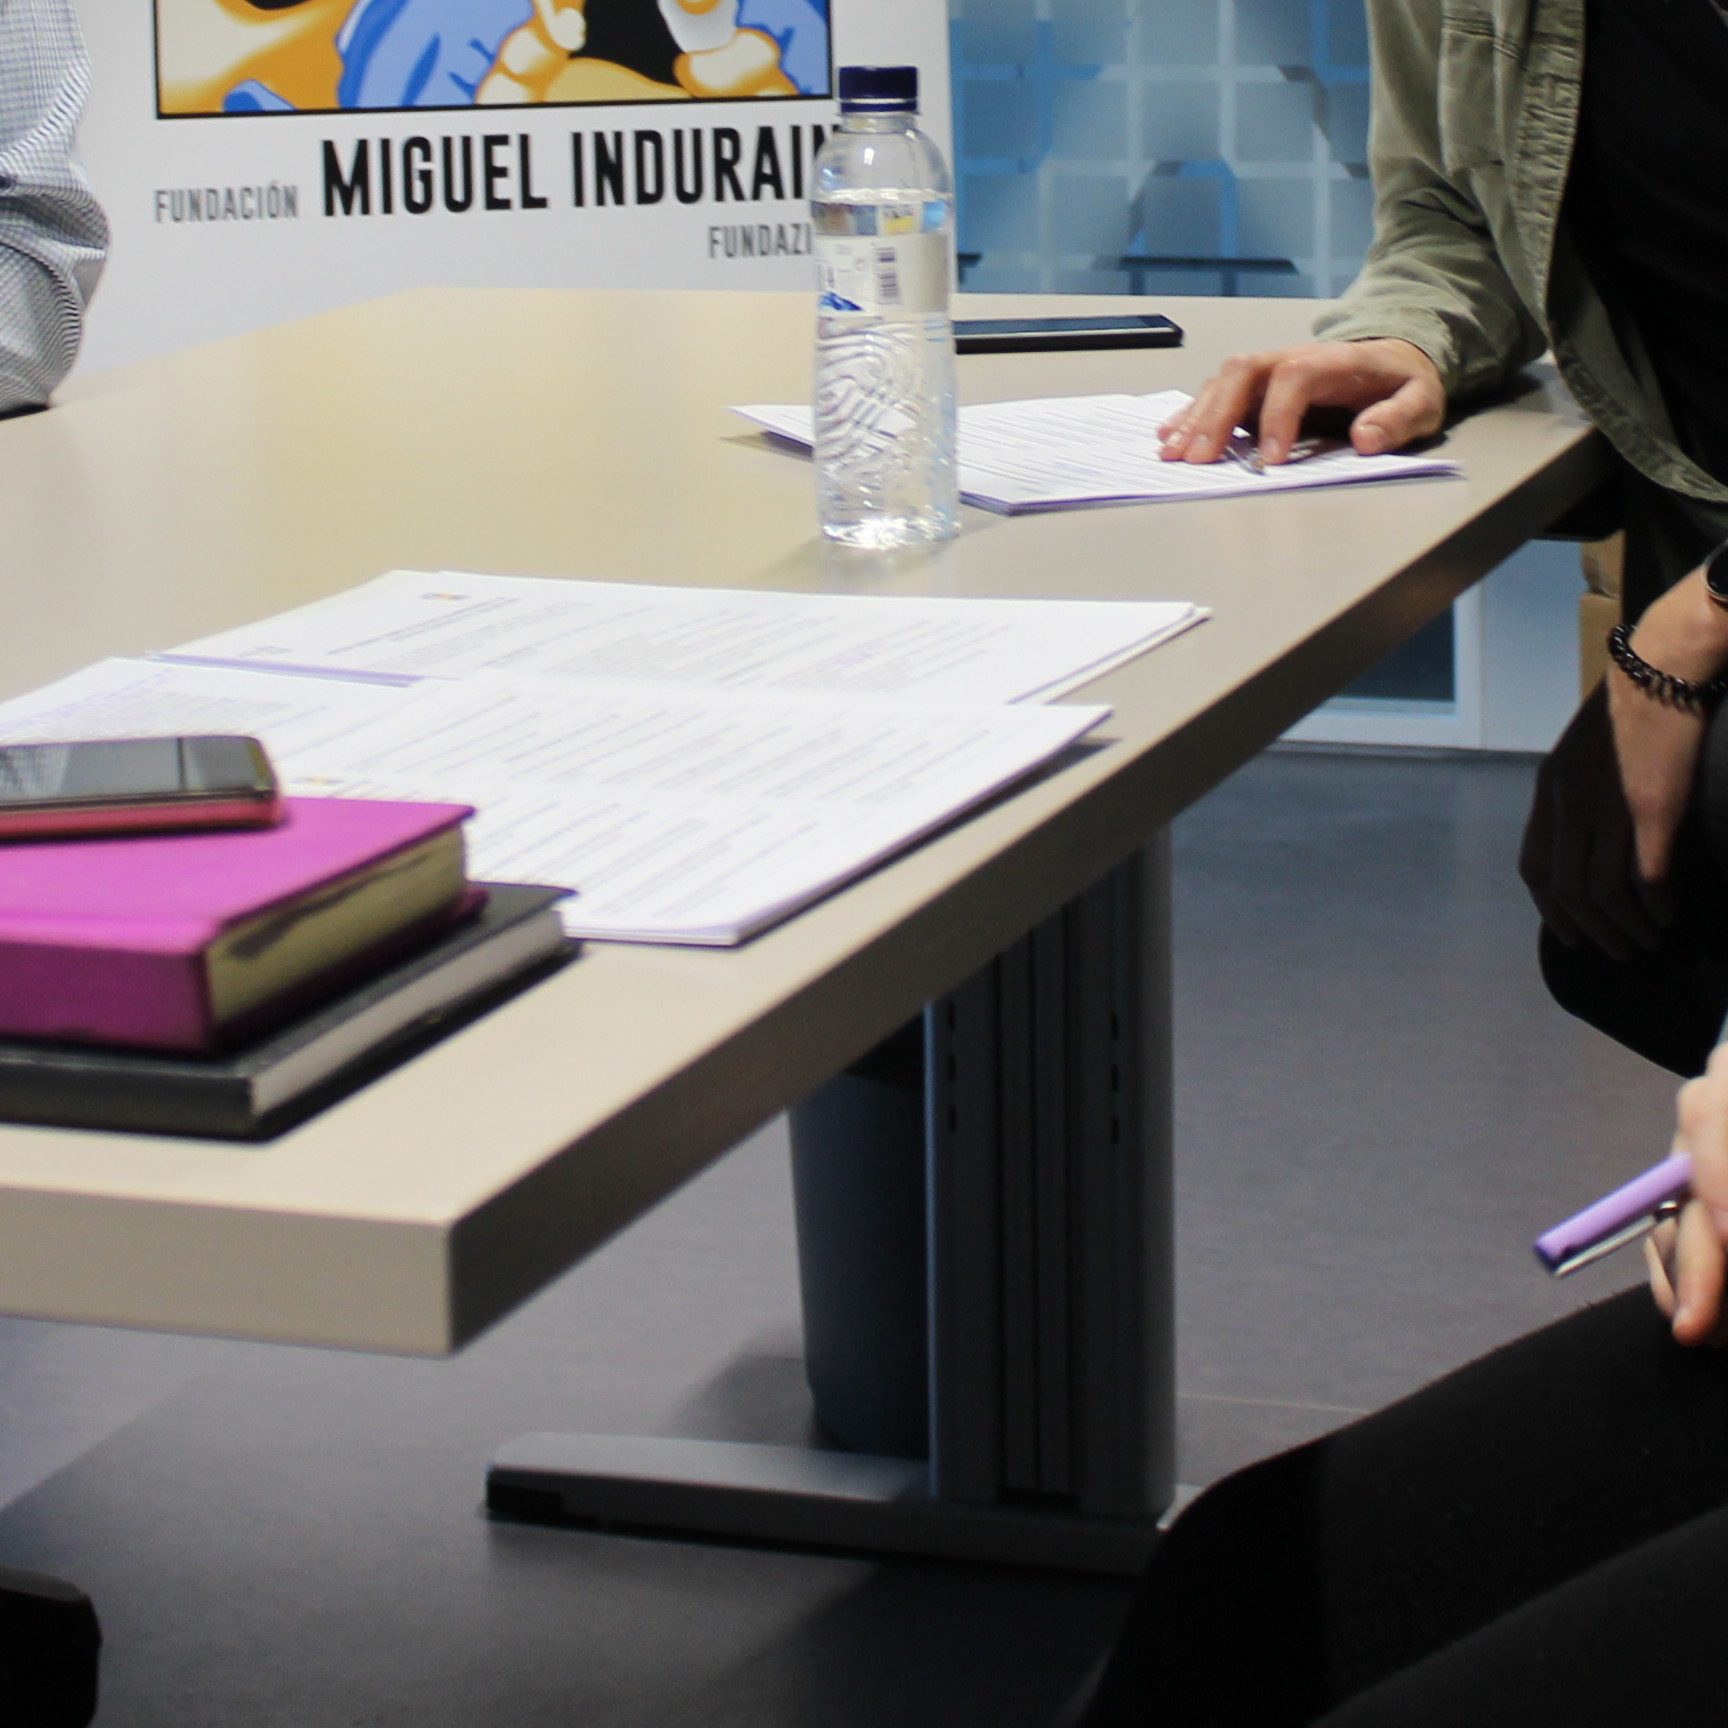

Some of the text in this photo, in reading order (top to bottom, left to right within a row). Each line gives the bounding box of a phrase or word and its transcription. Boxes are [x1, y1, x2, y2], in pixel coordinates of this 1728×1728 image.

[155, 124, 841, 223] FUNDACIÓN MIGUEL INDURAI
[709, 223, 813, 258] FUNDAZI
